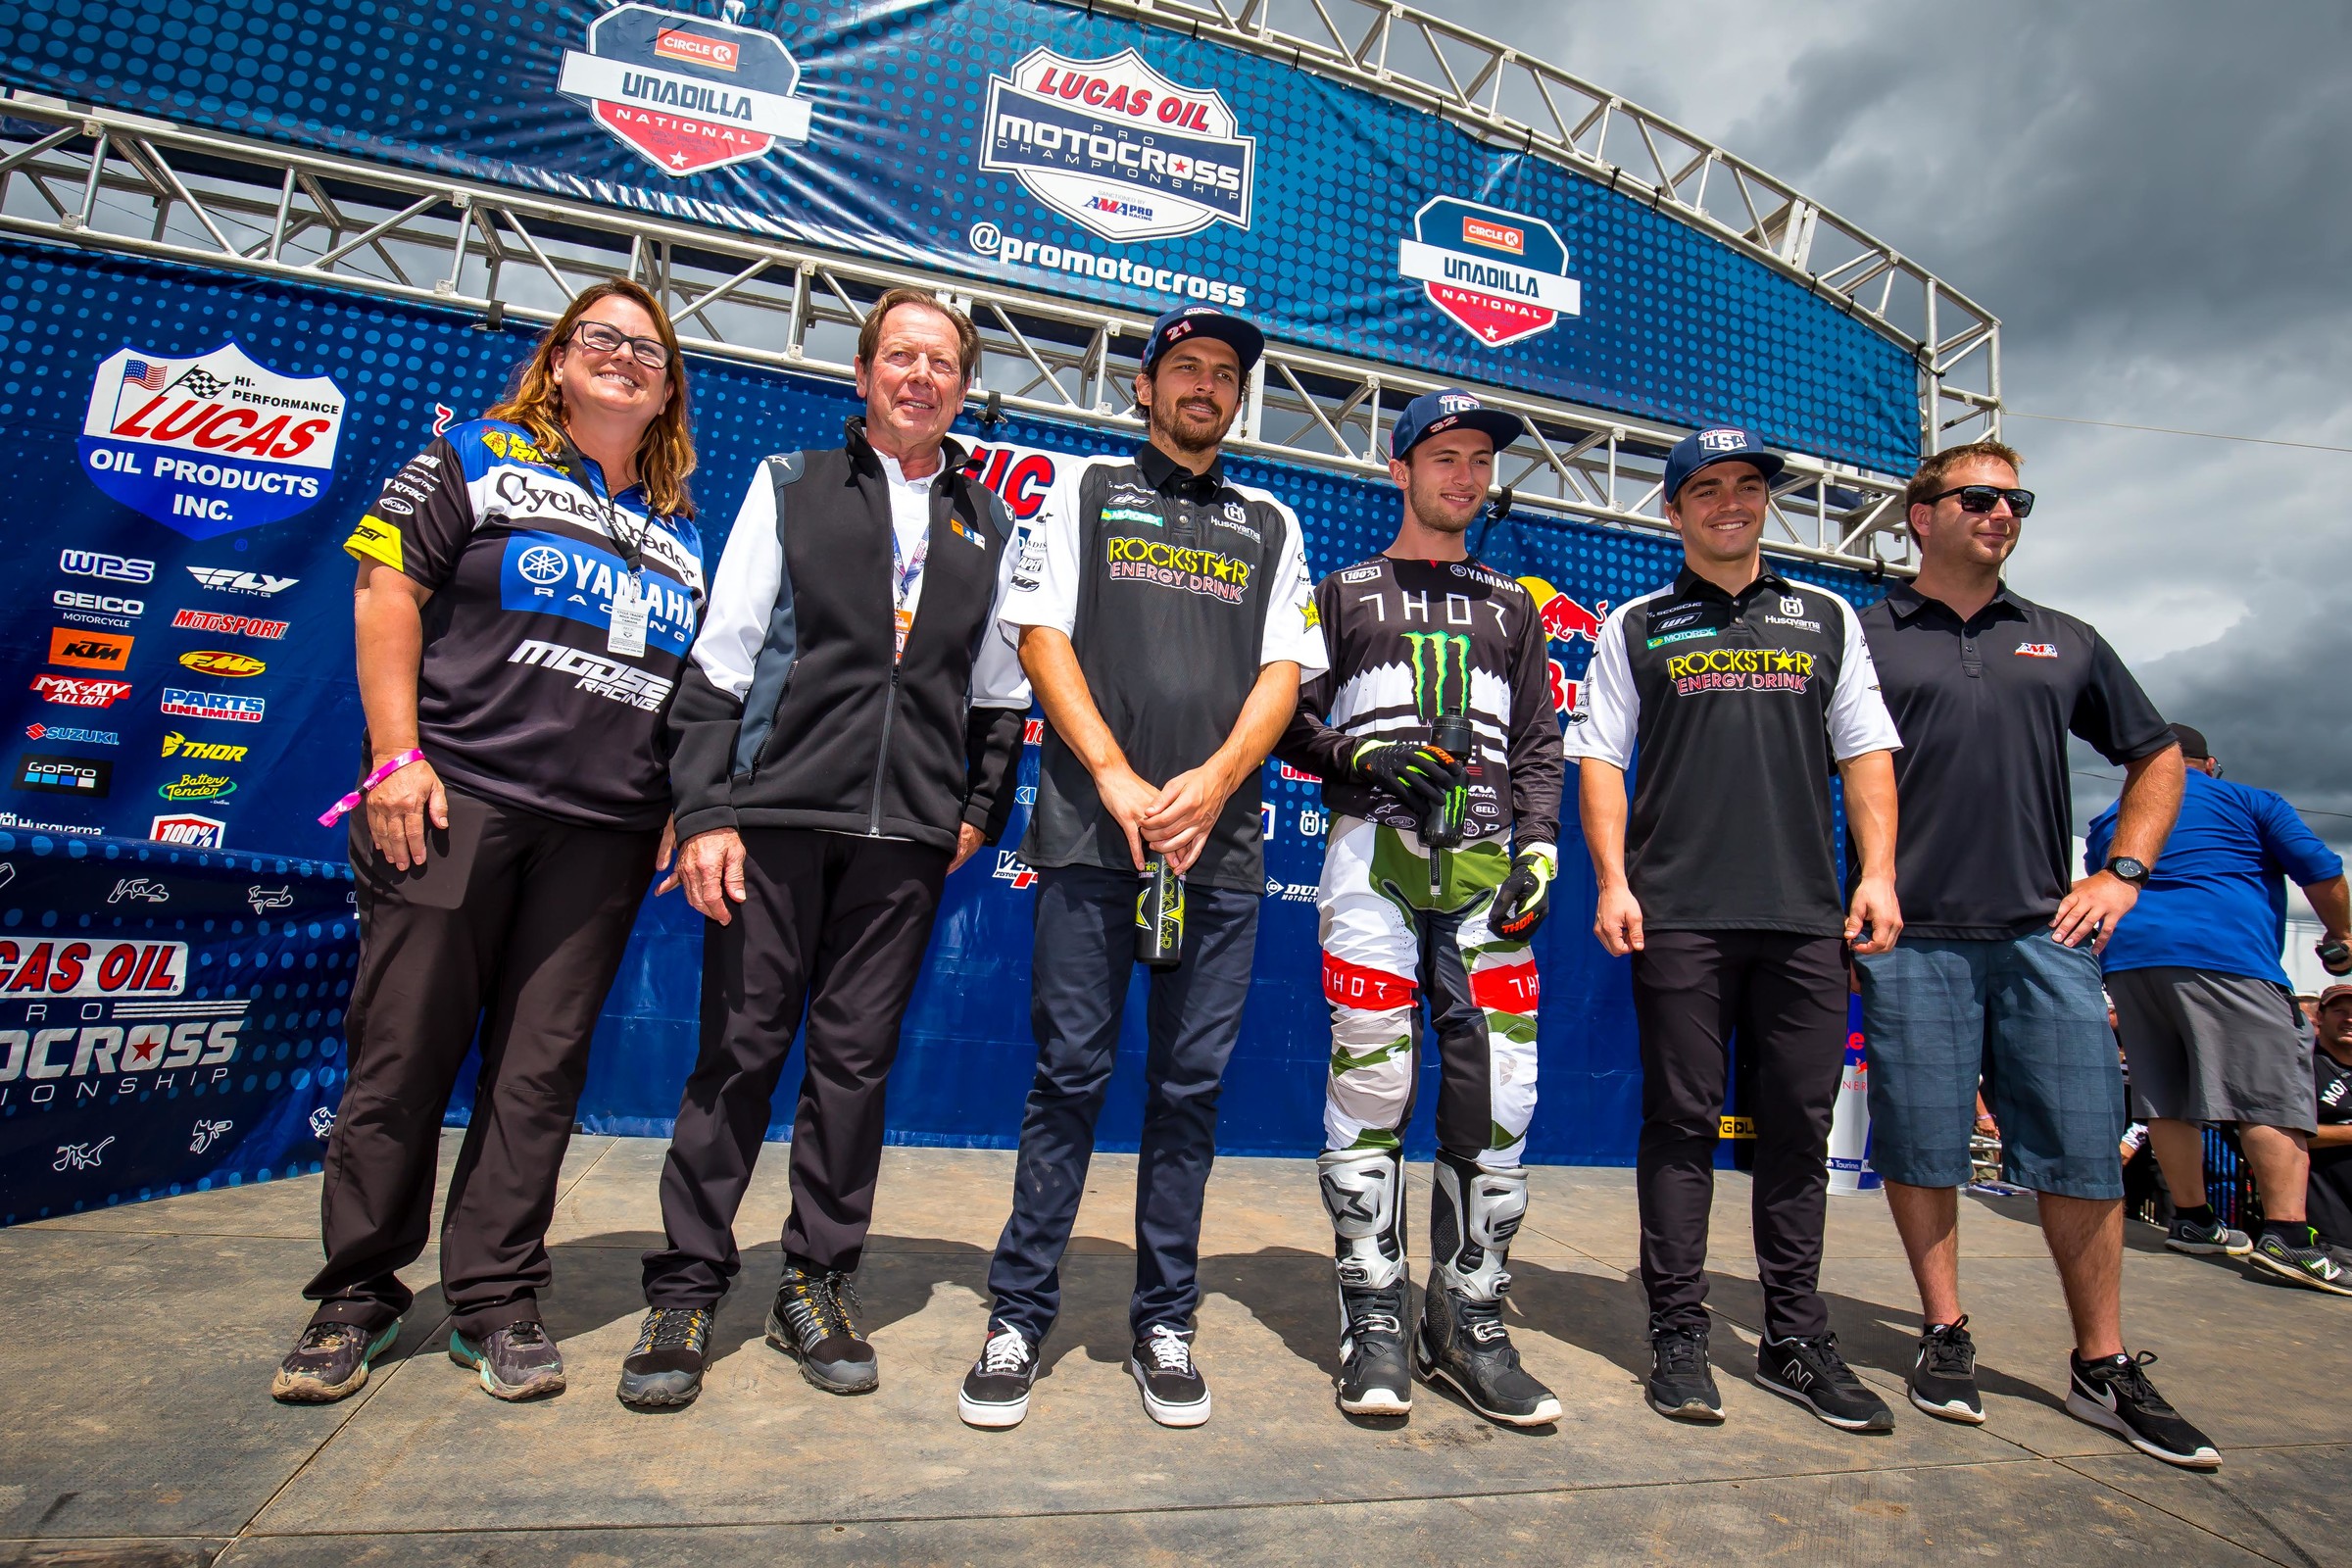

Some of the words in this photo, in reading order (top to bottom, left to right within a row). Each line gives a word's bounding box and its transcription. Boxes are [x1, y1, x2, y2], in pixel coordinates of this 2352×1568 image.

[663, 36, 710, 54] CIRCLE
[713, 45, 731, 62] K
[622, 72, 753, 122] UNADILLA
[1036, 67, 1152, 117] LUCAS
[1157, 97, 1210, 132] OIL
[615, 109, 752, 145] NATIONAL
[1093, 124, 1154, 146] PRO
[998, 114, 1241, 191] MOTOCROSS
[997, 138, 1239, 200] CHAMPIONSHIP
[1082, 196, 1128, 216] AMA
[1129, 205, 1153, 217] PRO
[1098, 190, 1136, 203] SANCTIONED
[1129, 213, 1152, 221] RACING
[1468, 224, 1502, 241] CIRCLE
[1504, 231, 1519, 246] K
[969, 221, 1247, 307] @promotocross
[1445, 256, 1540, 298] UNADILLA
[1442, 288, 1542, 319] NATIONAL
[1166, 320, 1192, 341] 21
[231, 391, 339, 415] PERFORMANCE
[110, 395, 331, 459] LUCAS
[1430, 416, 1458, 433] 32
[1705, 435, 1746, 449] USA
[89, 449, 142, 474] OIL
[153, 457, 318, 498] PRODUCTS
[172, 494, 233, 520] INC.
[1111, 510, 1161, 526] MOTOREX
[1211, 515, 1261, 540] Husqvarna
[60, 549, 156, 584] WPS
[1347, 568, 1377, 581] 100%
[185, 565, 300, 593] FLY
[1111, 562, 1184, 586] ENERGY
[1189, 573, 1244, 602] DRINK
[1467, 567, 1525, 594] YAMAHA
[53, 590, 144, 614] GEICO
[203, 584, 271, 598] RACING
[572, 554, 695, 635] YAMAHA
[63, 612, 130, 628] MOTORCYCLE
[533, 586, 685, 644] RACNG
[1765, 614, 1821, 629] Husqvarna
[1664, 628, 1714, 644] MOTOREX
[62, 641, 122, 662] KTM
[2015, 642, 2057, 655] AMA
[179, 651, 267, 673] FMF
[507, 639, 673, 701] MOOSE
[81, 682, 132, 697] ATV
[575, 676, 659, 712] RACING
[1677, 673, 1748, 694] ENERGY
[1751, 672, 1807, 692] DRINK
[46, 693, 78, 704] ALL
[79, 695, 110, 706] OUT
[164, 688, 265, 712] PARTS
[162, 704, 262, 722] UNLIMITED
[46, 727, 119, 745] SUZUKI
[181, 741, 248, 762] THOR
[27, 761, 97, 777] GoPro
[179, 773, 229, 787] Battery
[167, 784, 220, 801] Tender
[161, 823, 216, 848] 100%
[1281, 894, 1317, 903] MOTORCY
[1285, 884, 1320, 896] DUN
[1501, 910, 1535, 934] THOR
[0, 941, 92, 994] CAS
[98, 943, 177, 992] OIL
[25, 1003, 103, 1021] RO
[0, 1020, 245, 1082] OCROSS
[1, 1068, 228, 1105] IONSHIP
[1842, 1081, 1866, 1091] NER
[1723, 1121, 1756, 1134] GOL
